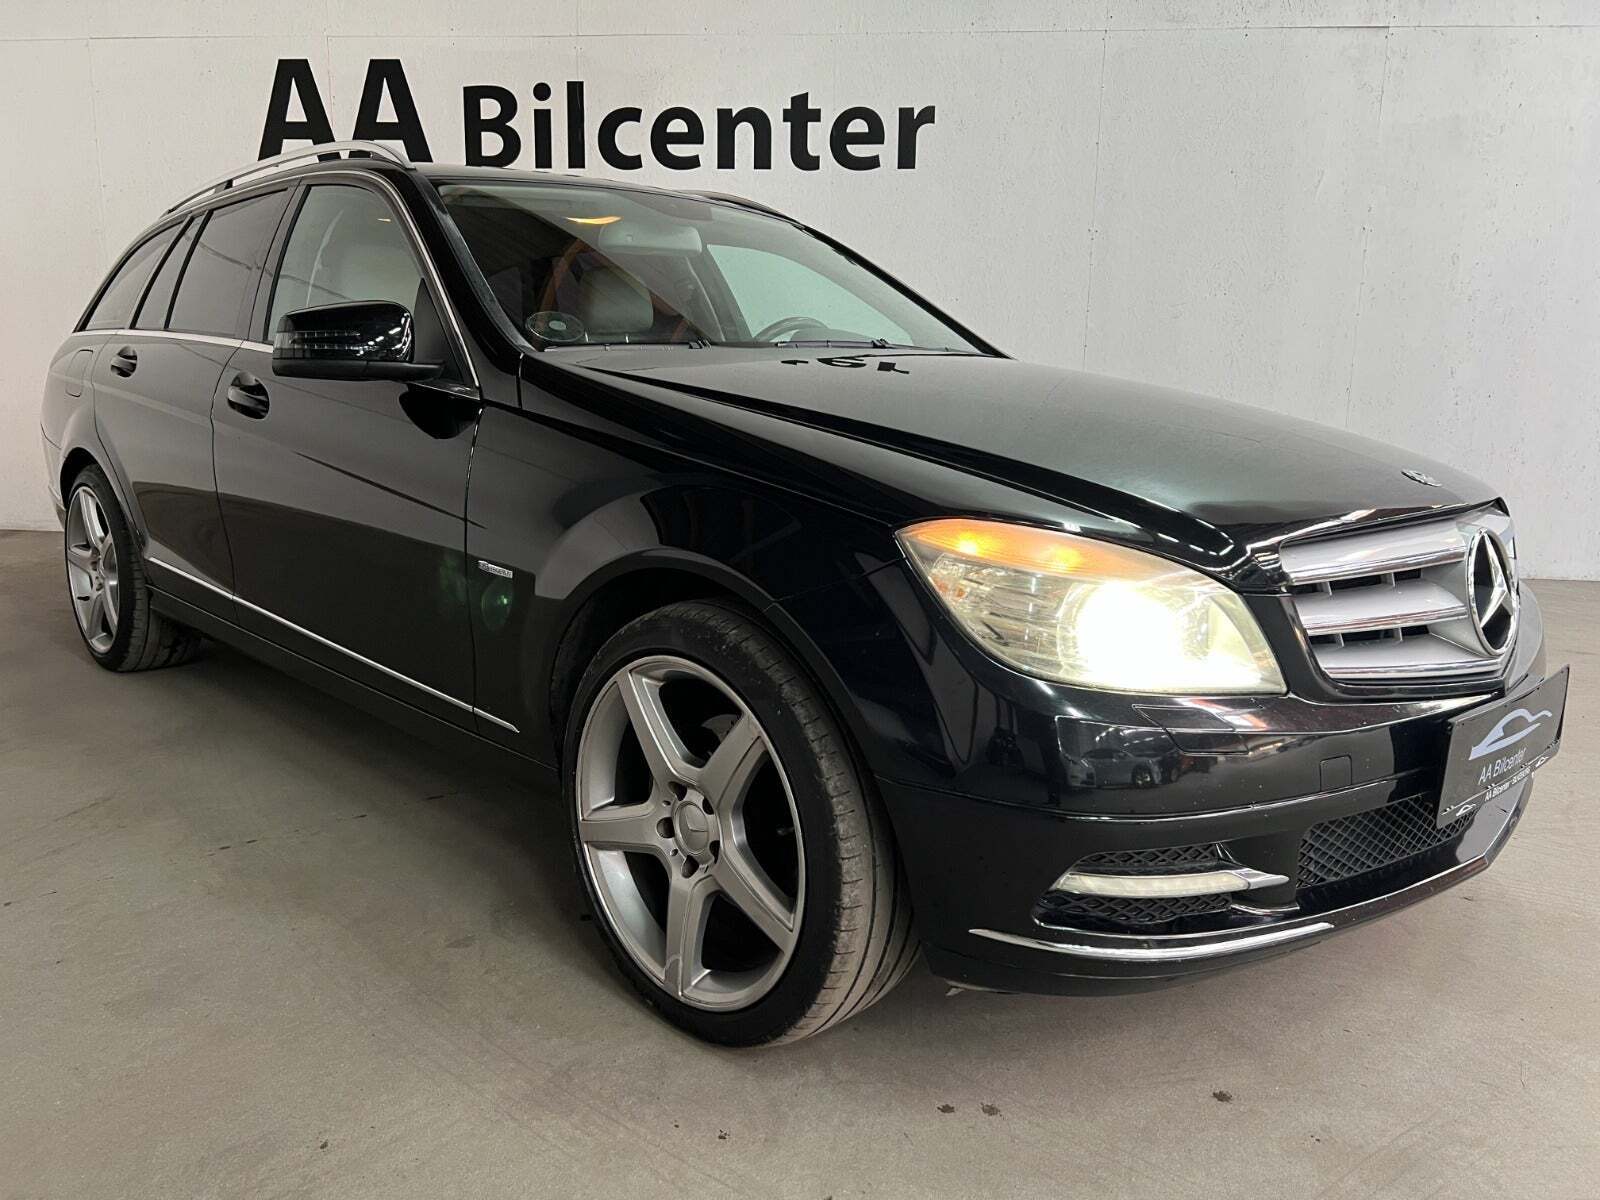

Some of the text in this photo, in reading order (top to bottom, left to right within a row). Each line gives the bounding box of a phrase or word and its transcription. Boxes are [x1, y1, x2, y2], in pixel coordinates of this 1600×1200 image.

[257, 58, 937, 171] AA Bilcenter
[1478, 763, 1492, 786] AA
[1493, 747, 1527, 778] Bilcenter
